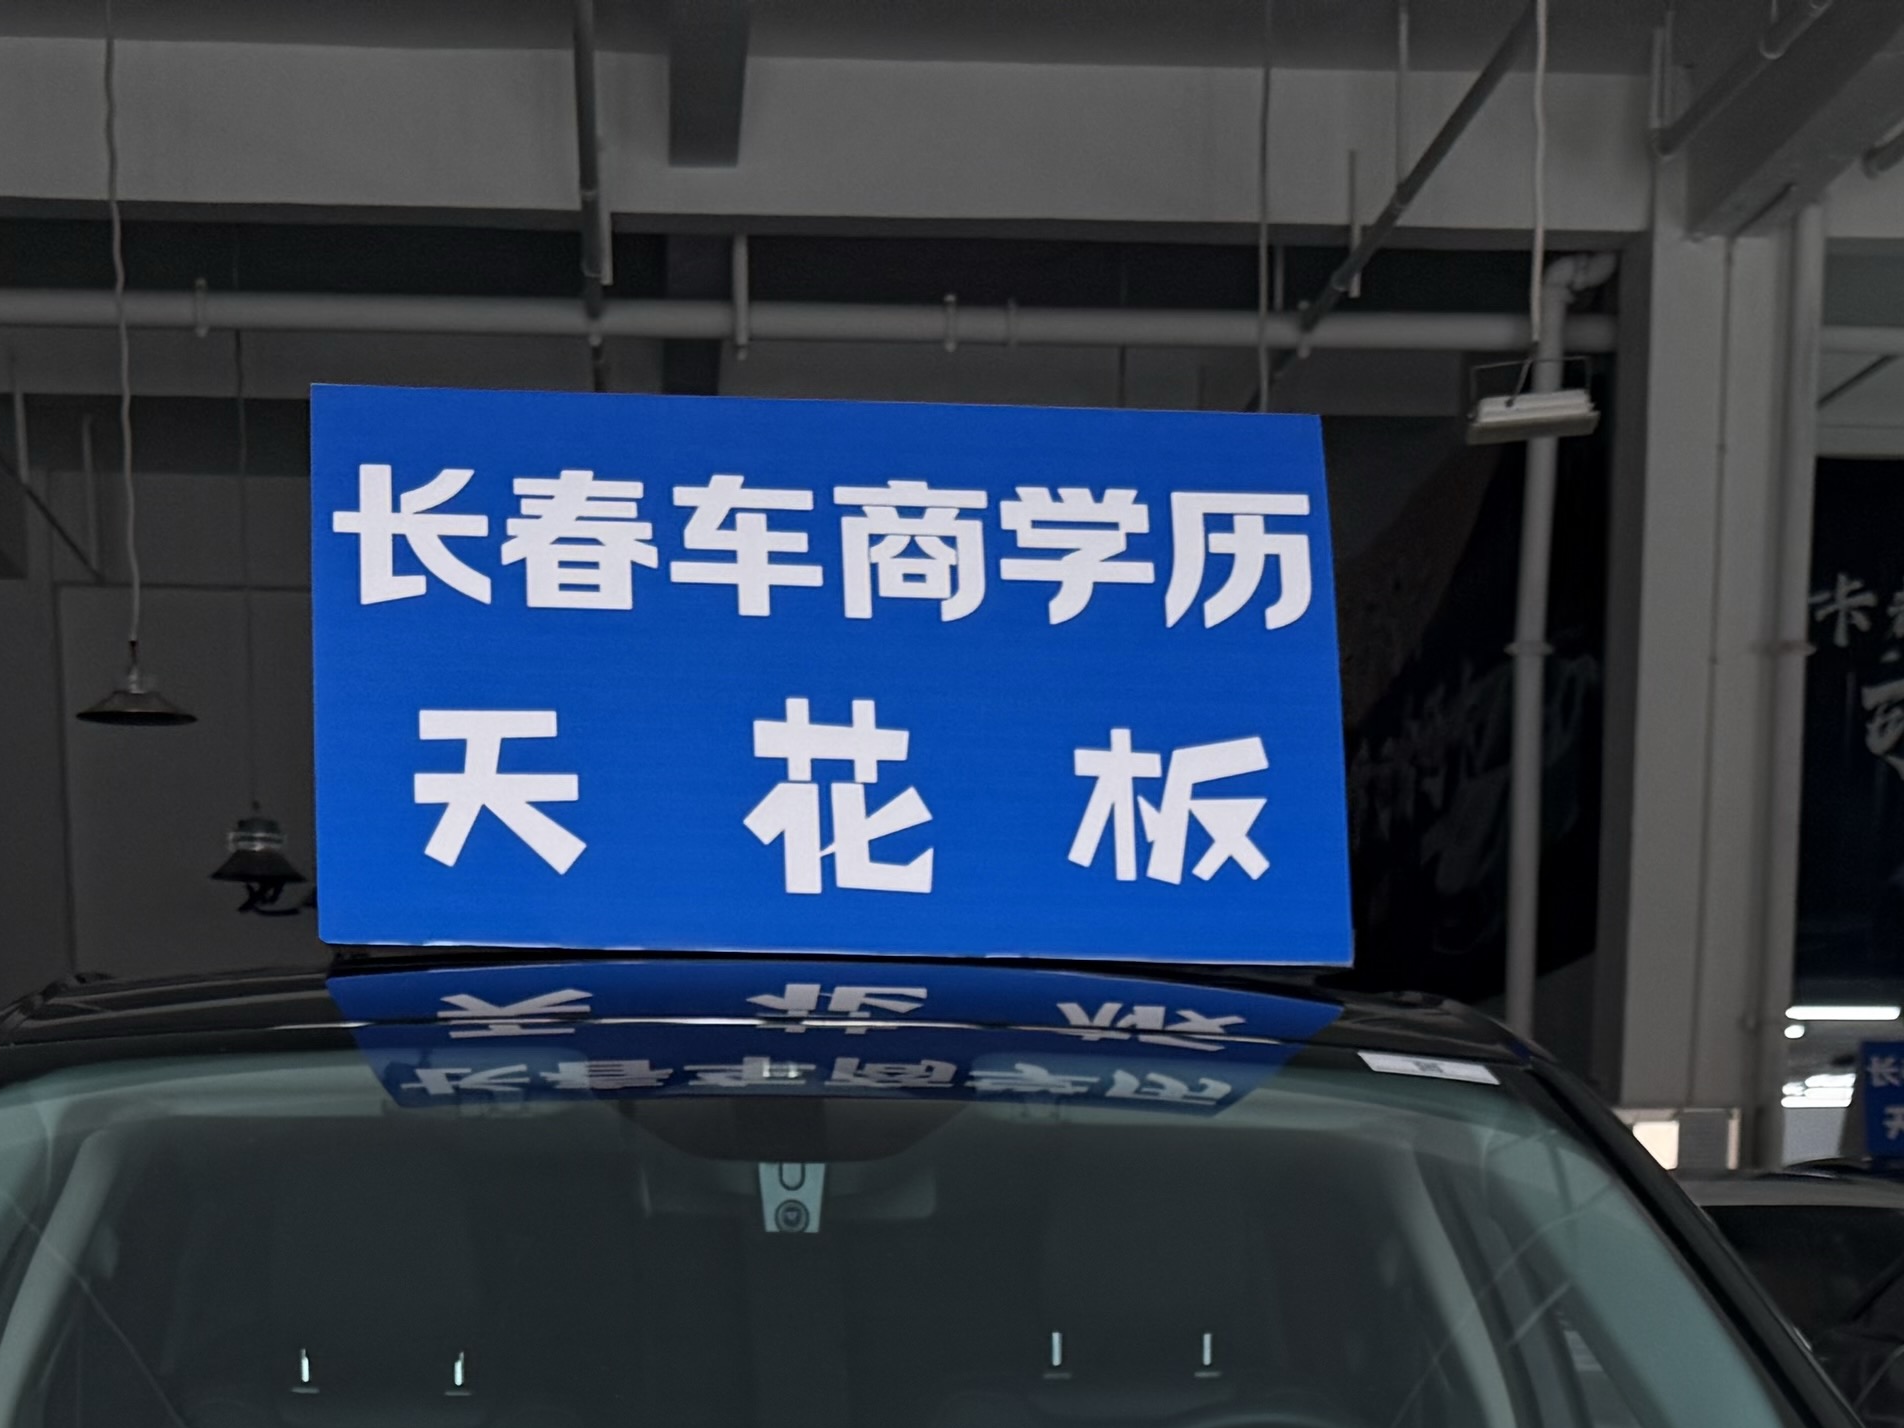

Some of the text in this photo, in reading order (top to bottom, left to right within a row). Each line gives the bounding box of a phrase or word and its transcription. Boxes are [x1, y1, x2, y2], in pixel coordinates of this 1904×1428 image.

[332, 464, 1313, 629] 长春车商学历
[413, 697, 1268, 893] 天花板
